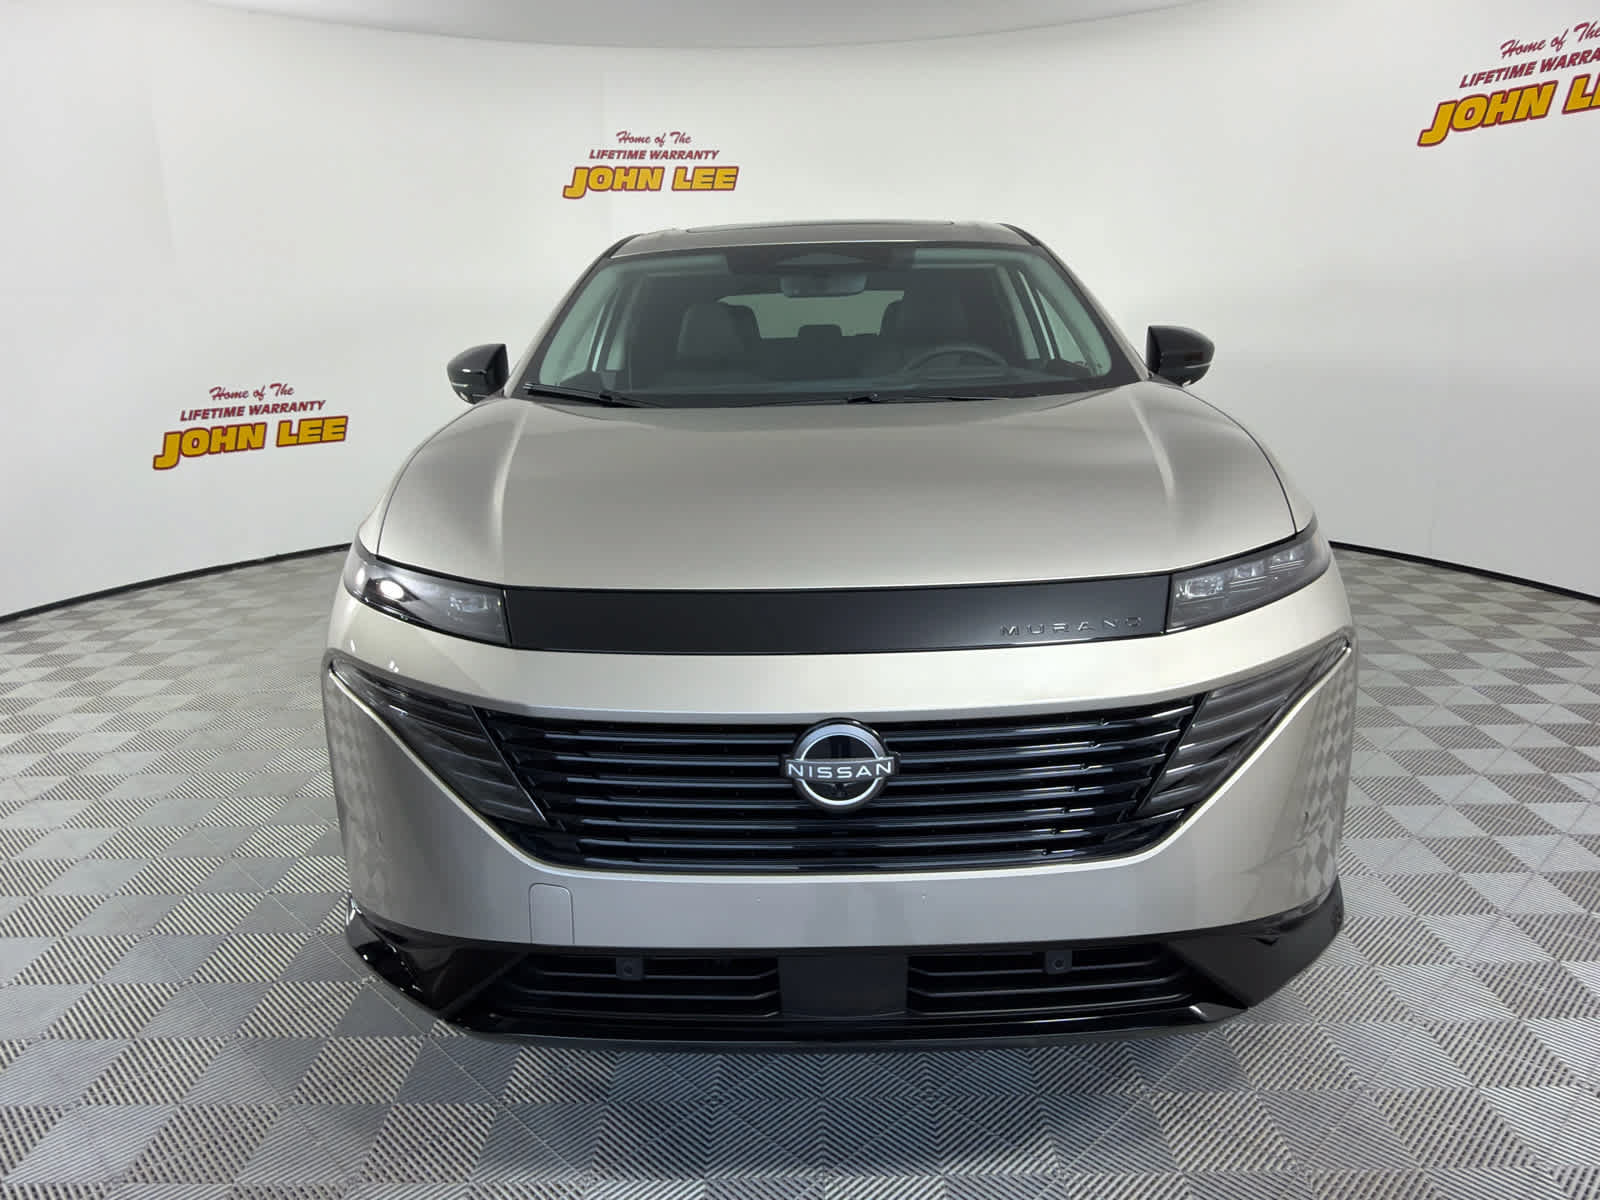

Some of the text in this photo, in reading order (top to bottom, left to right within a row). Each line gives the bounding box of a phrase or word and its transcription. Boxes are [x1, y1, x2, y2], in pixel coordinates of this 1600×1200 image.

[1500, 39, 1546, 58] Home
[1550, 28, 1569, 51] of
[1459, 61, 1537, 88] LIFETIME
[1417, 79, 1559, 147] JOHN
[616, 131, 692, 147] Home of The
[589, 149, 720, 160] LIFETIME WARRANTY
[562, 165, 739, 199] JOHN LEE
[209, 383, 294, 401] Home of The
[180, 400, 326, 421] LIFETIME WARRANTY
[153, 416, 348, 470] JOHN LEE
[1002, 616, 1142, 637] MURANO
[787, 761, 892, 779] NISSAN
